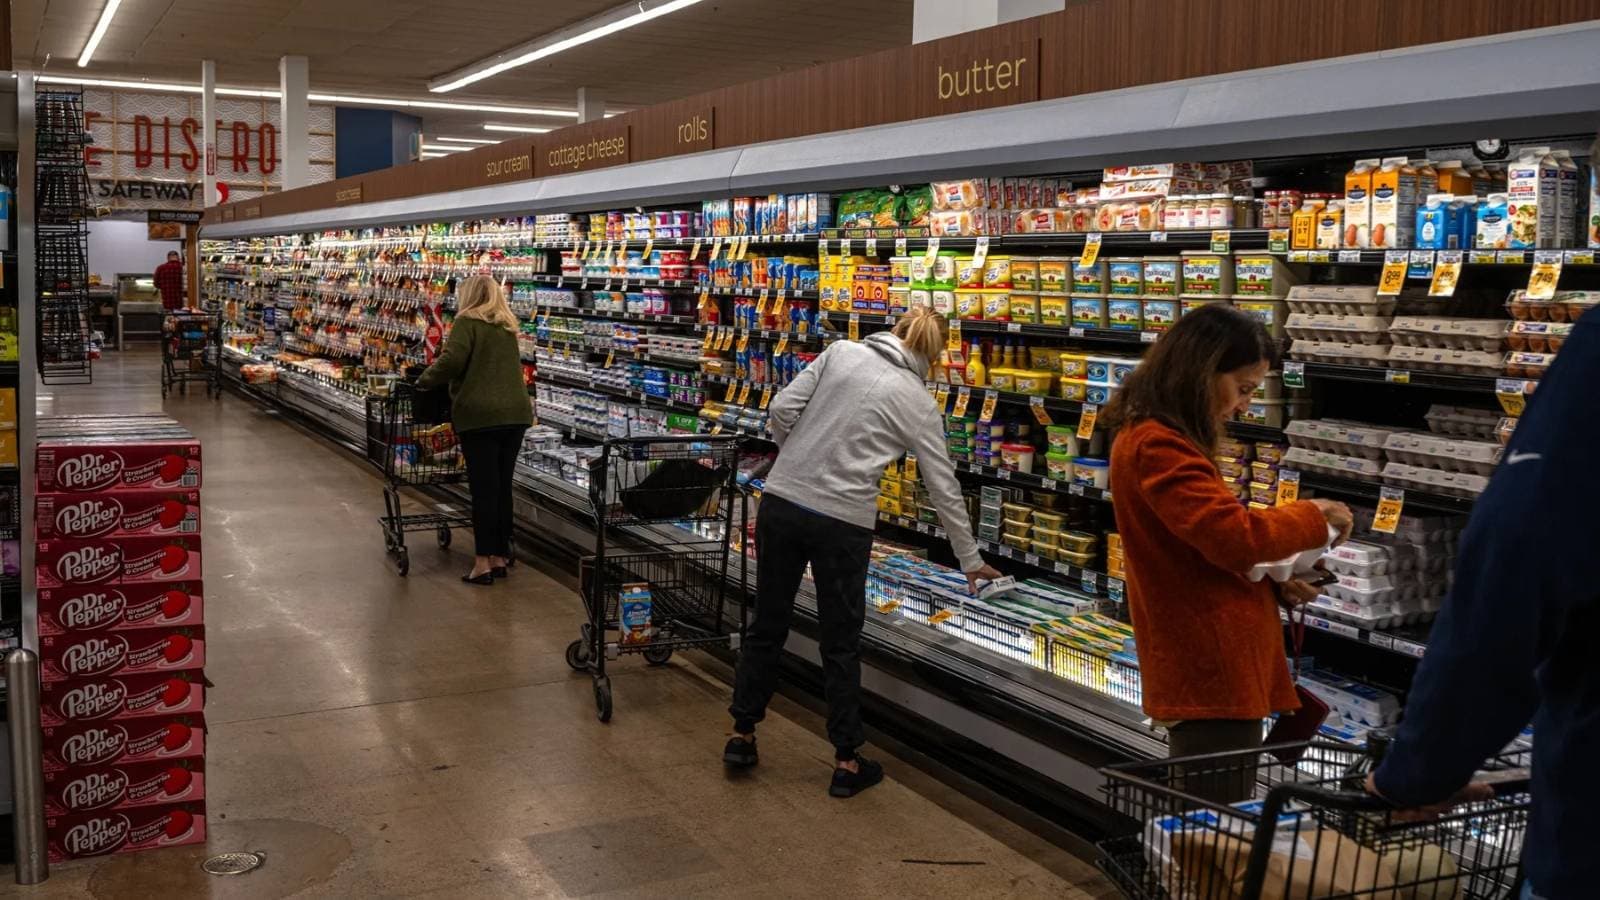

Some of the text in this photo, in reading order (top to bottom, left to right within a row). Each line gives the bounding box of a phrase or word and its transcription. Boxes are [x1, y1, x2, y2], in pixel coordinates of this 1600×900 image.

[939, 58, 1026, 99] butter
[678, 116, 708, 144] rolls
[134, 115, 275, 174] BISRO
[549, 136, 625, 169] cottage cheese
[486, 153, 530, 177] sour cream
[99, 182, 198, 200] SAFEWAY
[65, 458, 119, 487] Pepper
[81, 454, 104, 471] Dr
[124, 460, 167, 477] Strawberries
[80, 500, 103, 516] Dr
[123, 506, 166, 524] Strawberries
[64, 505, 119, 534] Pepper
[81, 546, 104, 562] Dr
[124, 552, 167, 569] Strawberries
[65, 551, 120, 580] Pepper
[84, 593, 106, 608] Dr
[126, 597, 168, 615] Strawberries
[67, 597, 122, 627] Pepper
[85, 638, 109, 654] Dr
[69, 643, 124, 673] Pepper
[83, 683, 106, 699] Dr
[68, 688, 122, 718] Pepper
[85, 729, 108, 745] Dr
[69, 733, 123, 763] Pepper
[86, 773, 109, 789] Dr
[70, 777, 124, 808] Pepper
[88, 818, 110, 834] Dr
[72, 822, 126, 853] Pepper
